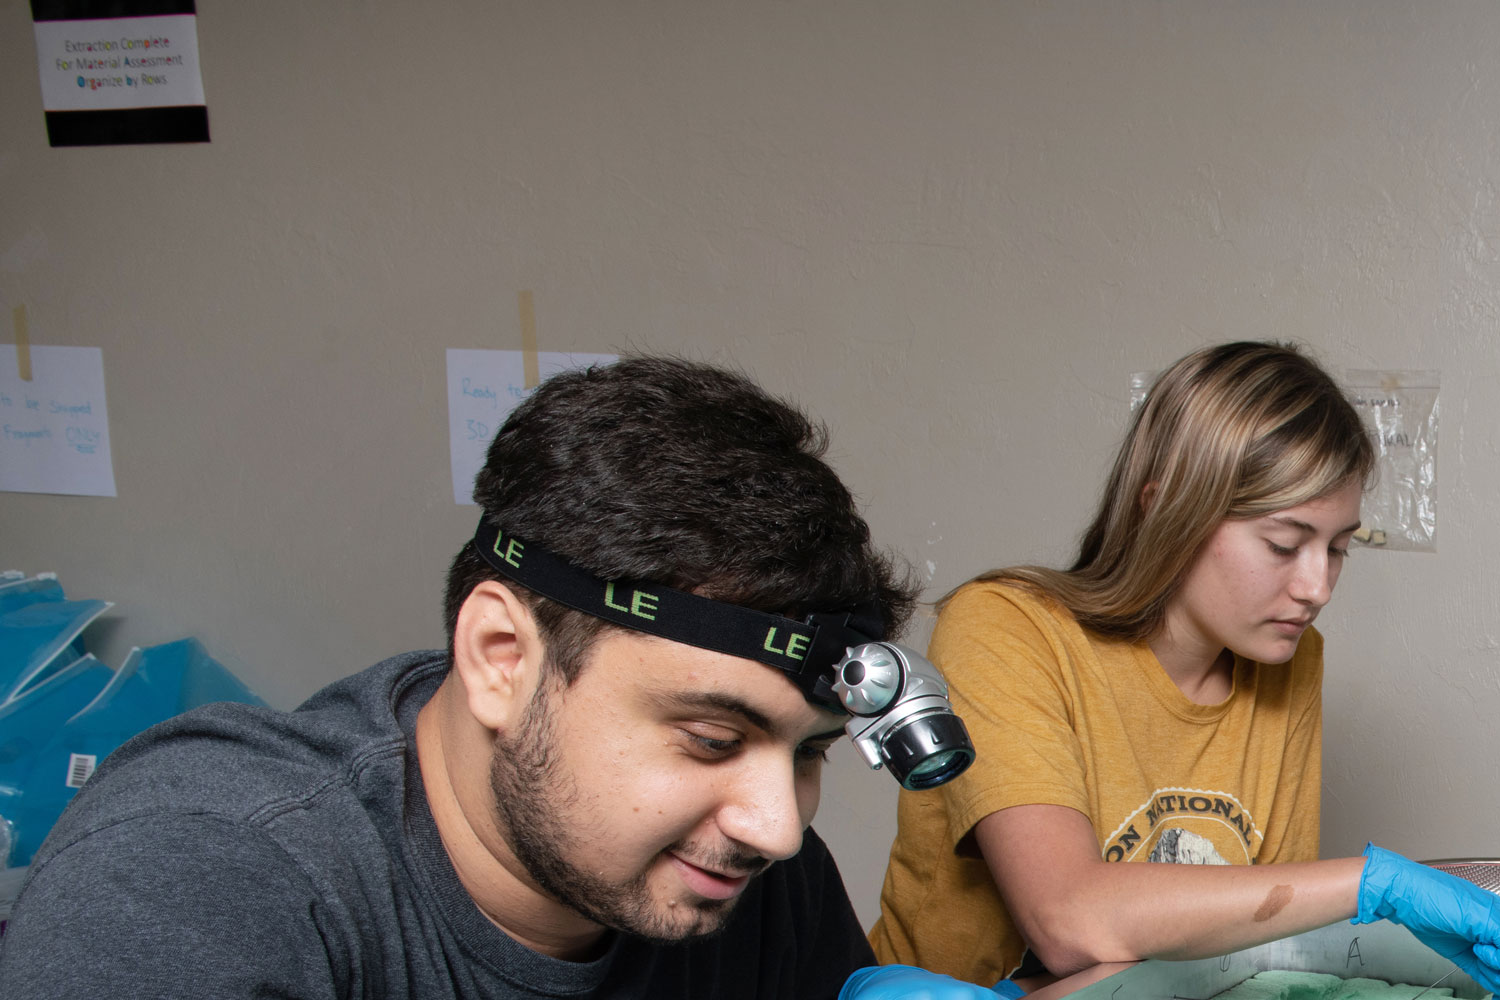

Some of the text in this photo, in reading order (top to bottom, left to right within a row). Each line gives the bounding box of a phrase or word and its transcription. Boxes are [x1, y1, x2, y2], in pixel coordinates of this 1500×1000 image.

[64, 35, 170, 53] Extraction Complete
[56, 55, 183, 71] For Material Assessment
[77, 73, 168, 91] Organize by Rows
[493, 530, 524, 568] LE
[604, 582, 659, 620] LE
[763, 626, 810, 660] LE
[1146, 795, 1251, 847] NATIONAL
[1346, 936, 1366, 969] A
